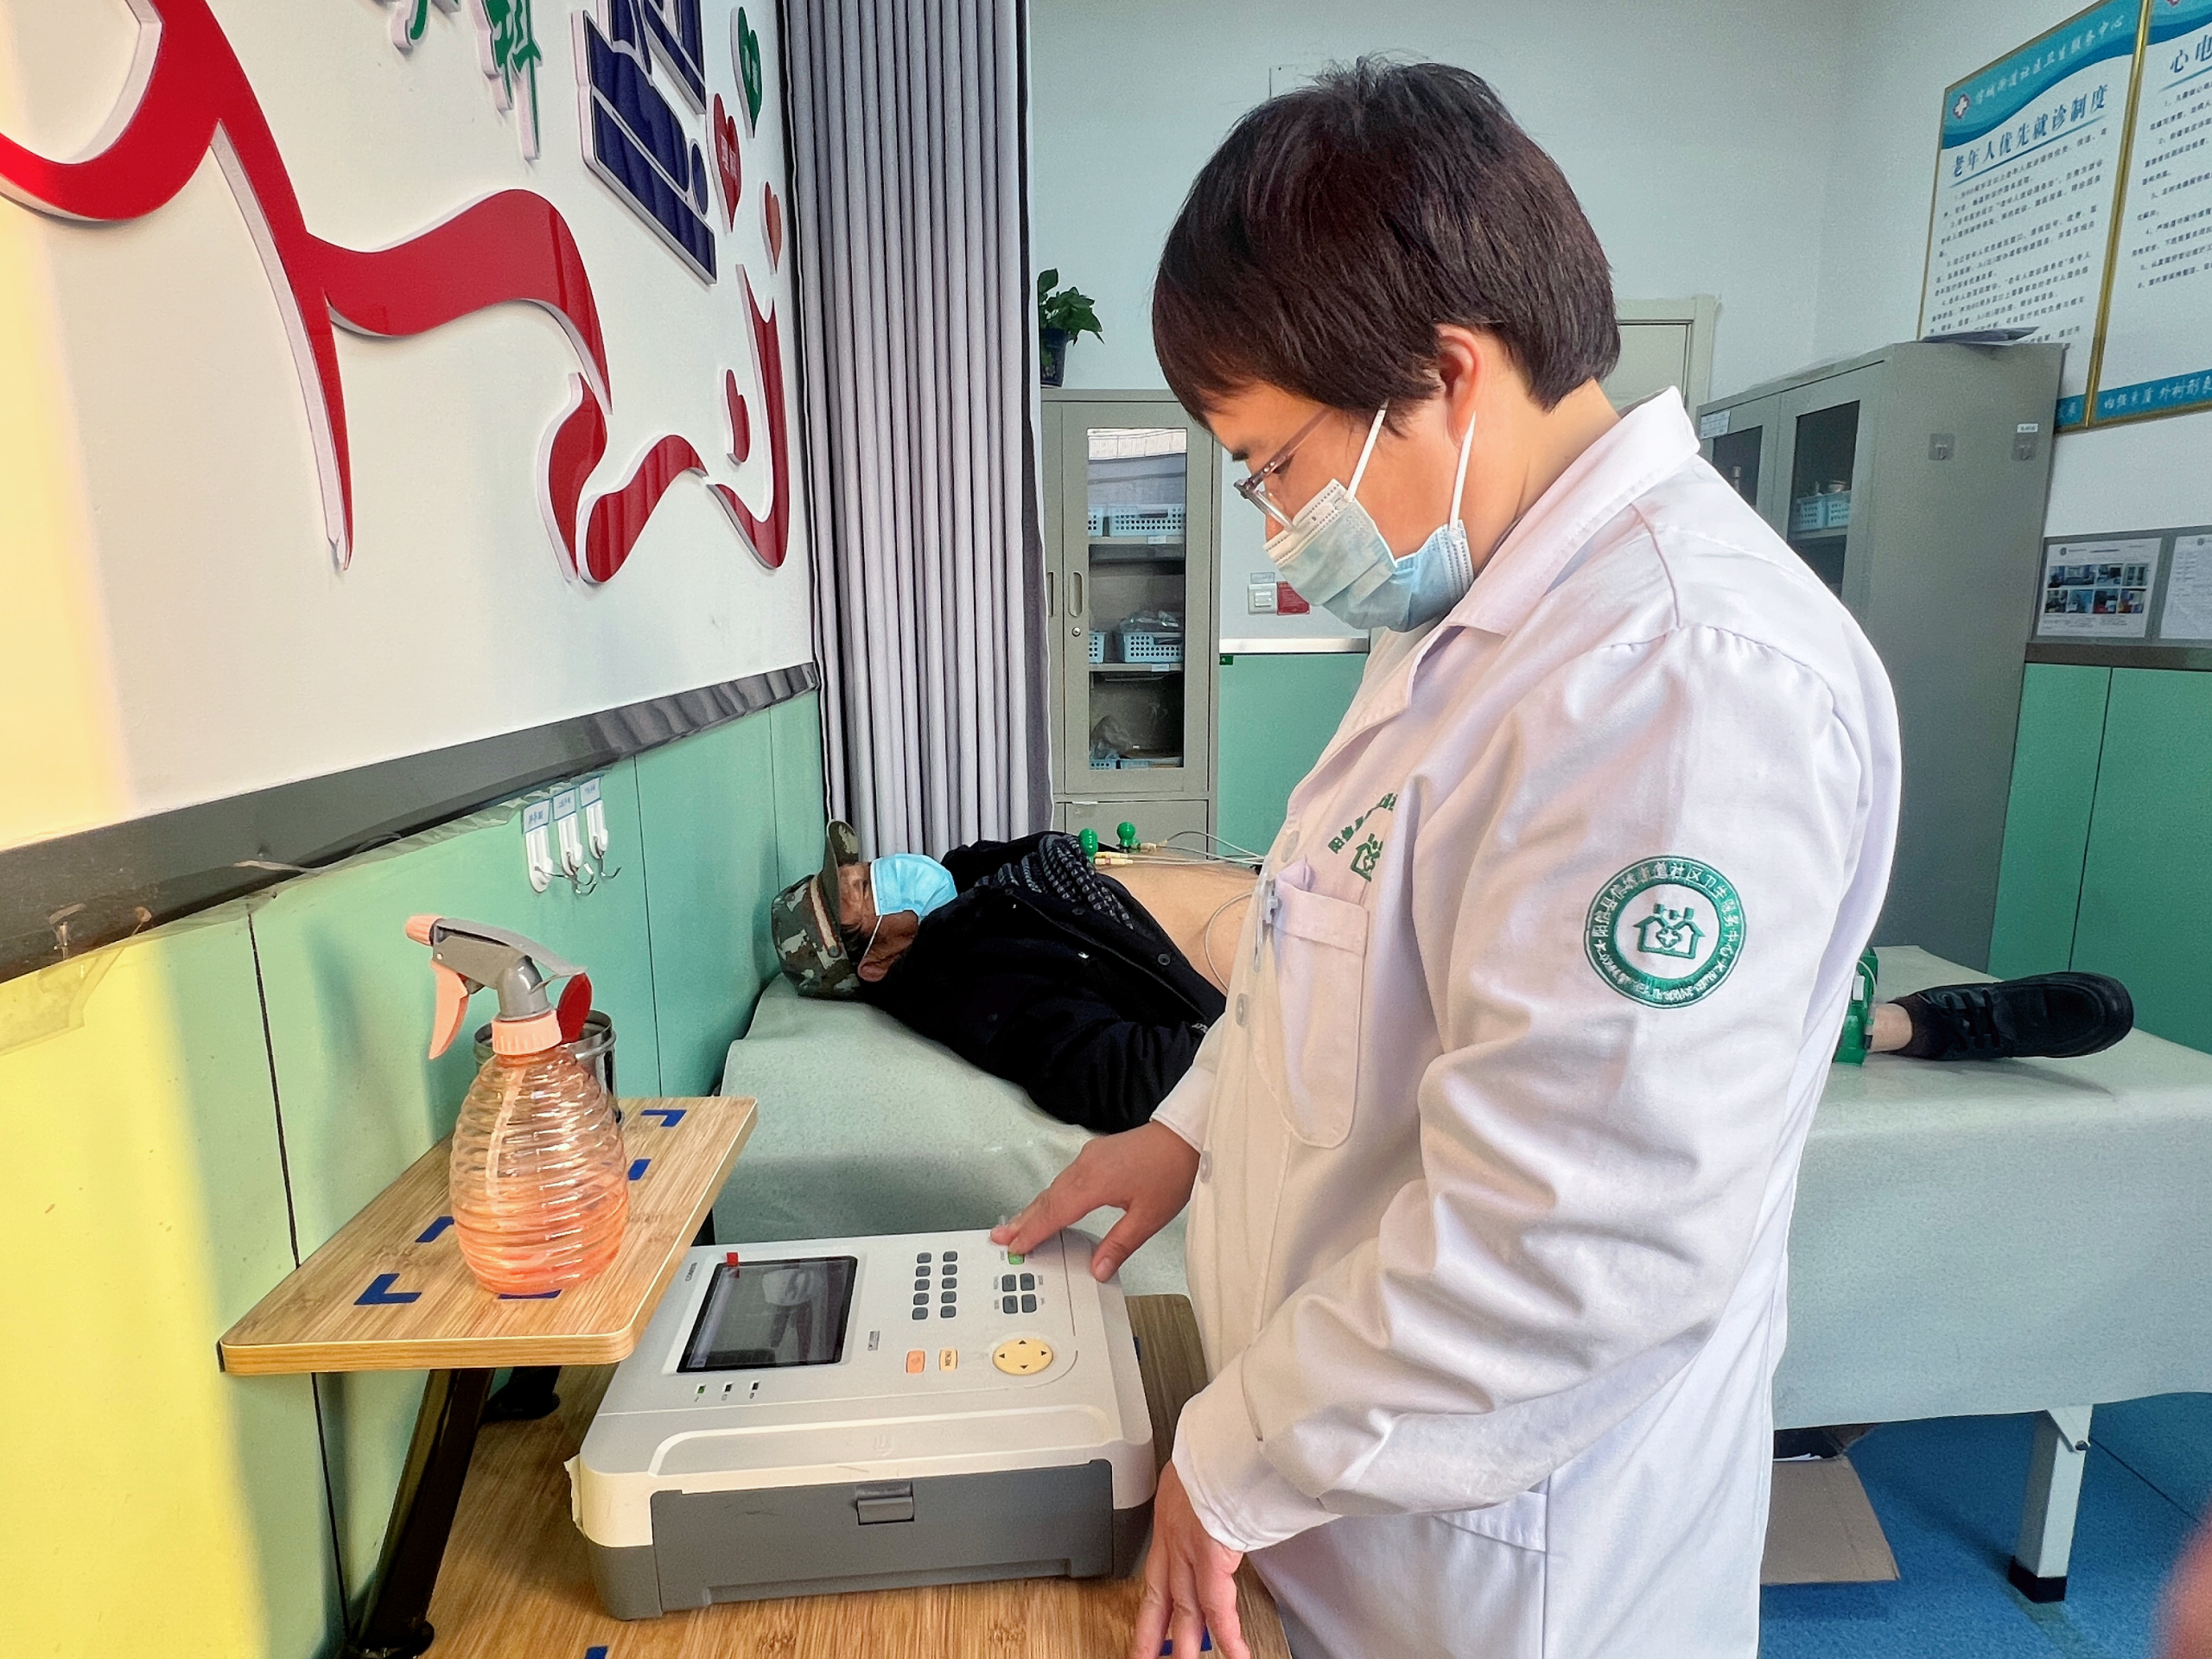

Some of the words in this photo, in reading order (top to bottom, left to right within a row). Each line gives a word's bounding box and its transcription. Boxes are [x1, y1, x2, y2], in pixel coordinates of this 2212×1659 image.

[1953, 84, 2108, 177] 老年人优先就诊制度
